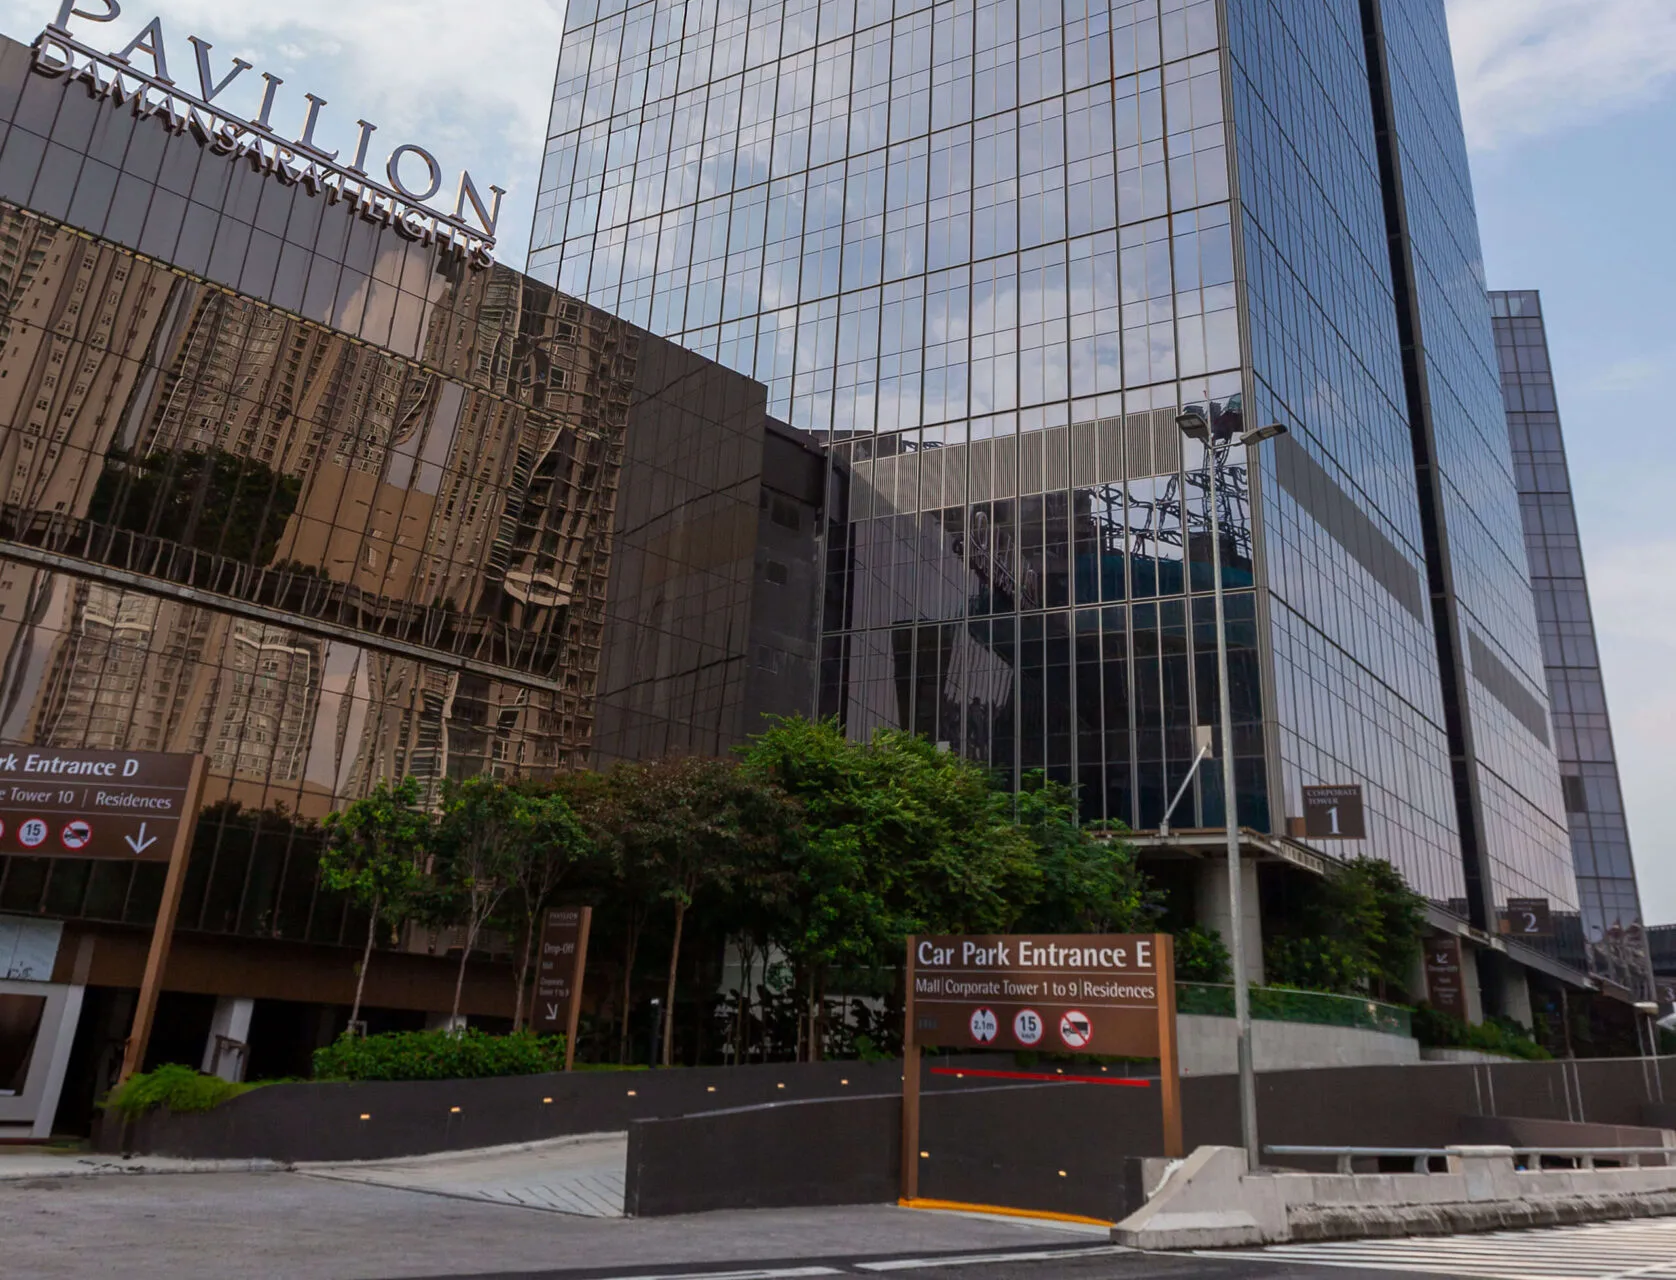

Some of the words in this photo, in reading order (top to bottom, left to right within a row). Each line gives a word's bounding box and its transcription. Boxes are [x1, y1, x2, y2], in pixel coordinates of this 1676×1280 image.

[36, 33, 323, 195] DAMANSARA
[0, 753, 18, 771] rk
[24, 754, 116, 777] Entrance
[122, 758, 140, 777] D
[10, 787, 51, 803] Tower
[57, 790, 75, 804] 10
[95, 791, 172, 810] Residences
[26, 823, 42, 837] 15
[1325, 806, 1343, 835] 1
[1522, 912, 1539, 933] 2
[917, 940, 954, 966] Car
[962, 940, 1010, 967] Park
[1018, 940, 1127, 968] Entrance
[1136, 940, 1152, 968] E
[915, 978, 940, 993] Mall
[945, 979, 1000, 997] Corporate
[1003, 980, 1038, 996] Tower
[1042, 981, 1049, 995] 1
[1052, 982, 1066, 996] to
[1068, 982, 1078, 996] 9
[1083, 981, 1155, 999] Residences
[973, 1020, 995, 1031] 2.1m
[1020, 1015, 1037, 1032] 15
